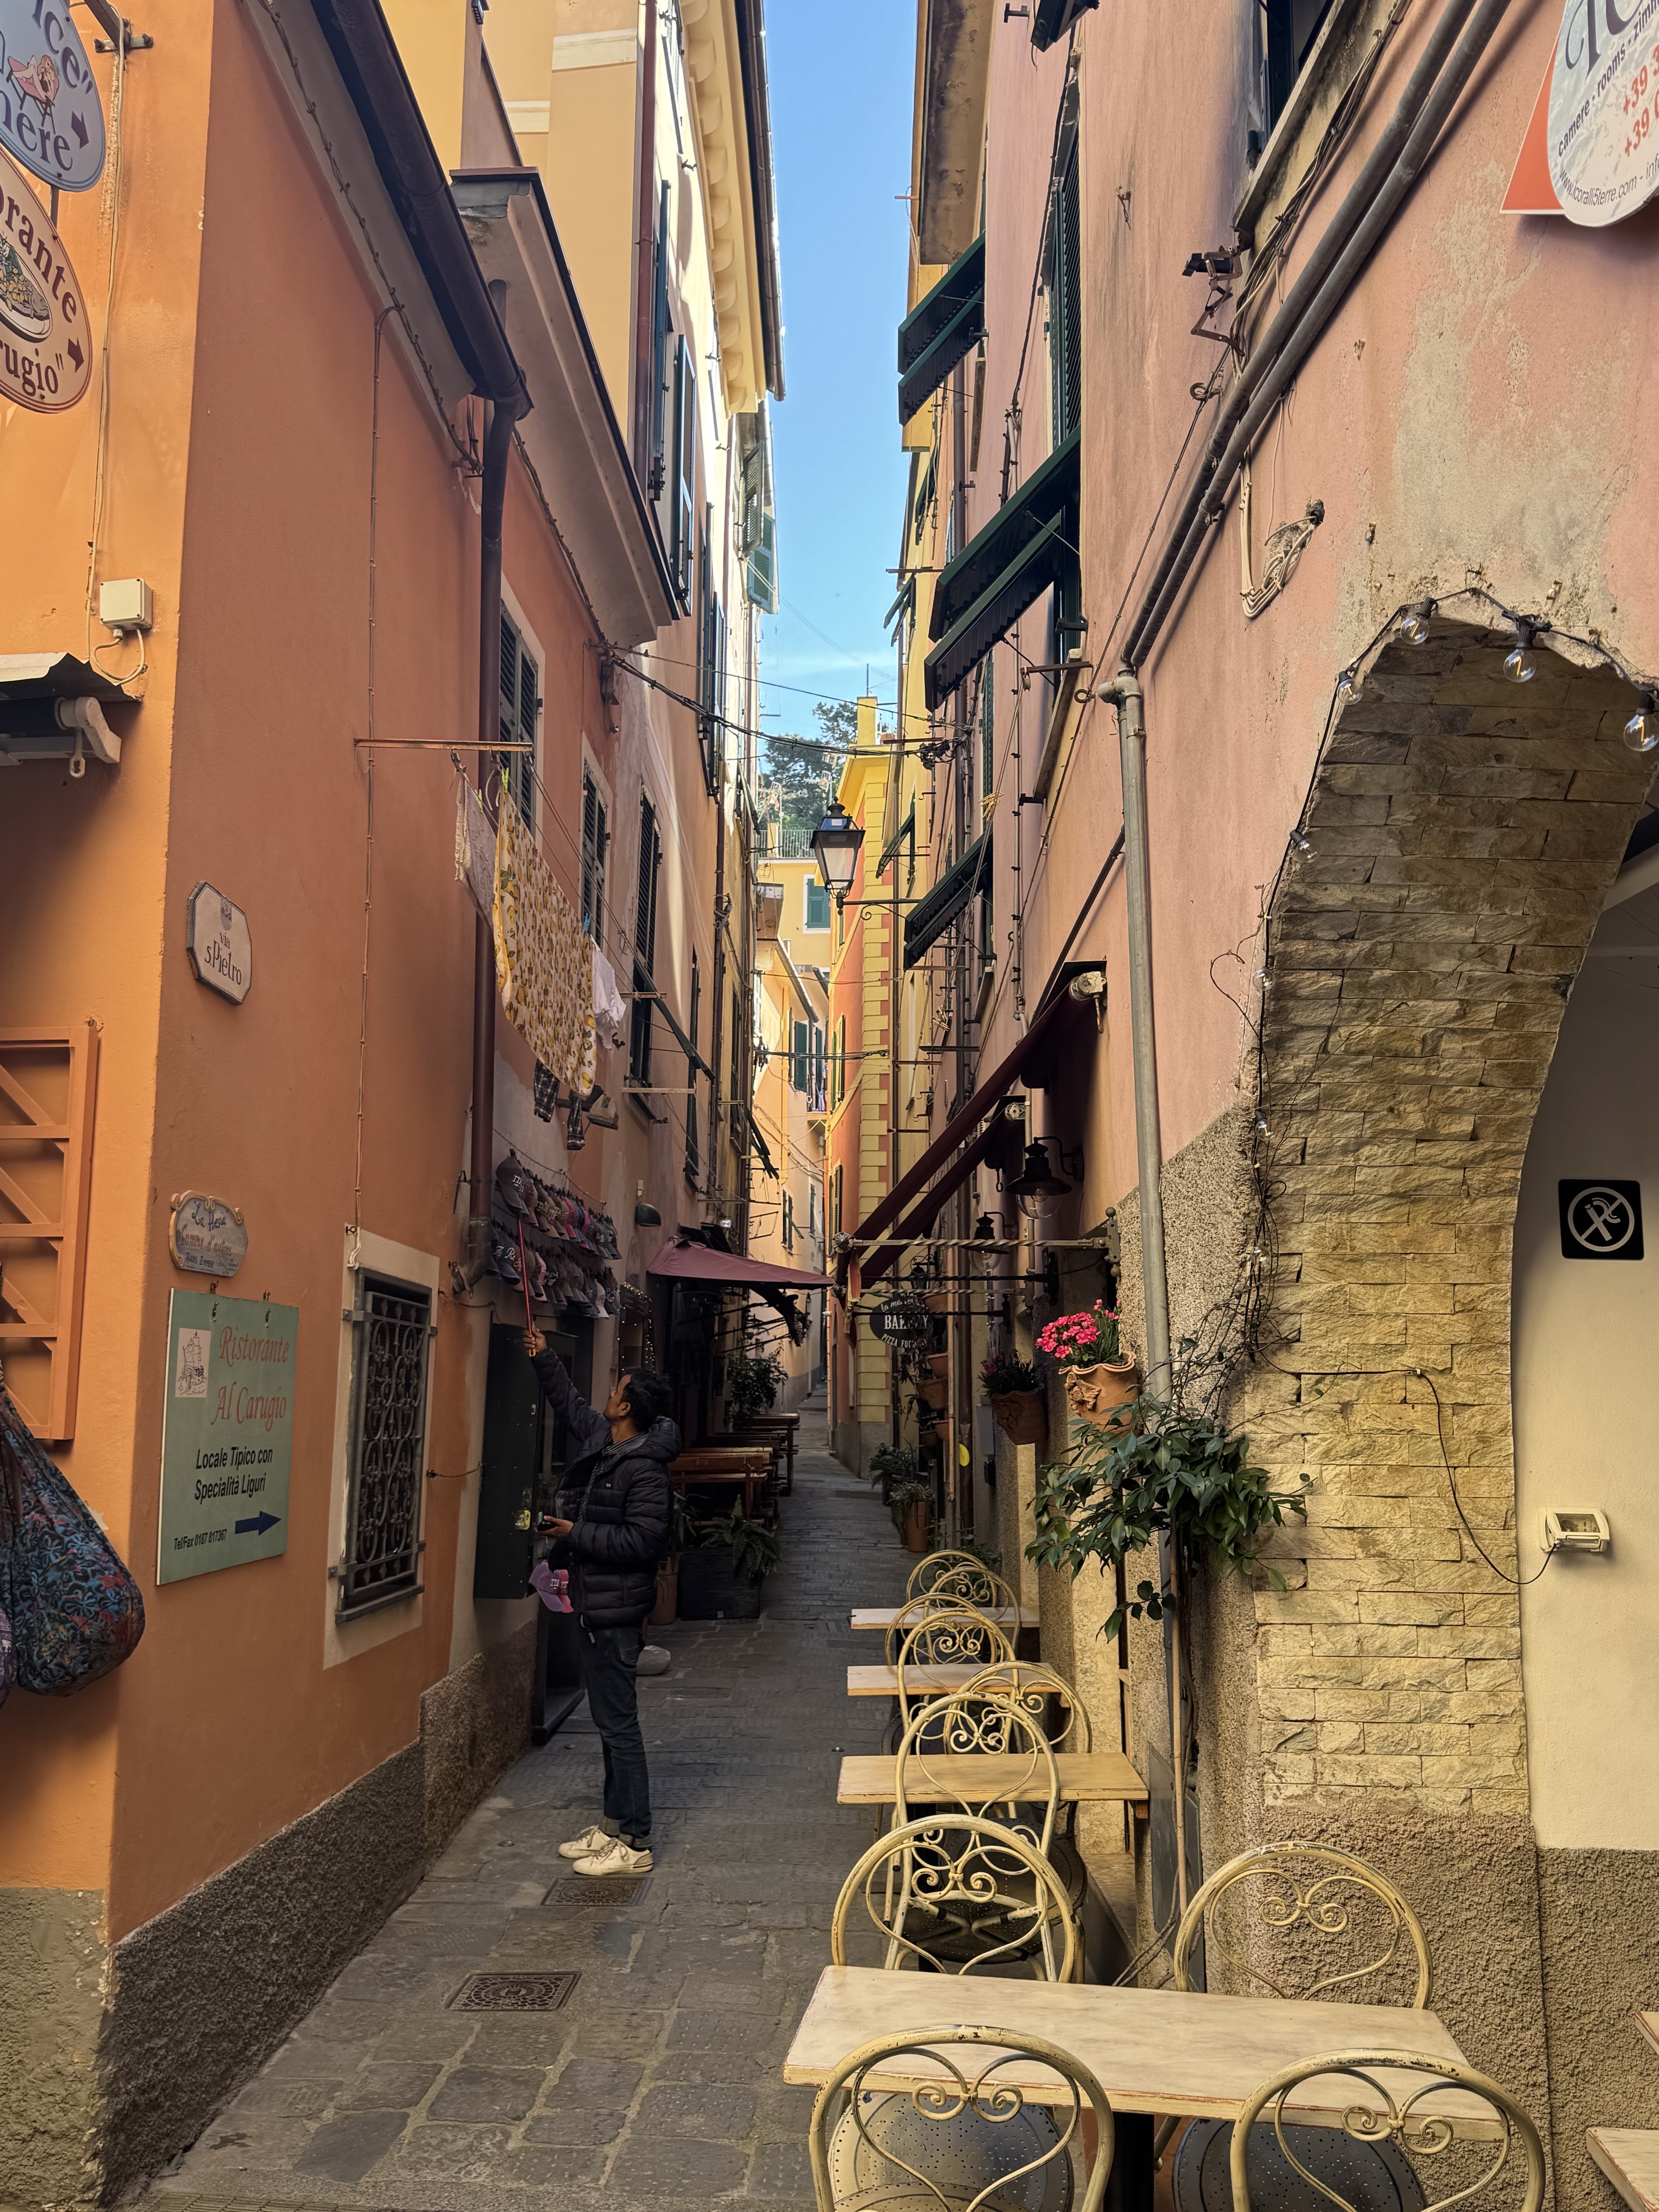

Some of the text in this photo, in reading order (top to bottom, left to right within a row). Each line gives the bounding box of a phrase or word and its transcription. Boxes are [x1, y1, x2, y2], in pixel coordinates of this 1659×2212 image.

[1559, 99, 1590, 157] camere
[1597, 43, 1626, 98] rooms
[1623, 64, 1648, 116] +39
[1625, 106, 1650, 157] +39
[219, 932, 231, 949] via
[220, 1325, 289, 1367] Ristorante
[881, 1333, 897, 1346] PIZZA
[211, 1381, 287, 1432] Al Carugio
[196, 1446, 273, 1471] Locale Tipico con
[195, 1472, 267, 1504] Specialità Liguri
[195, 1532, 208, 1546] 0187
